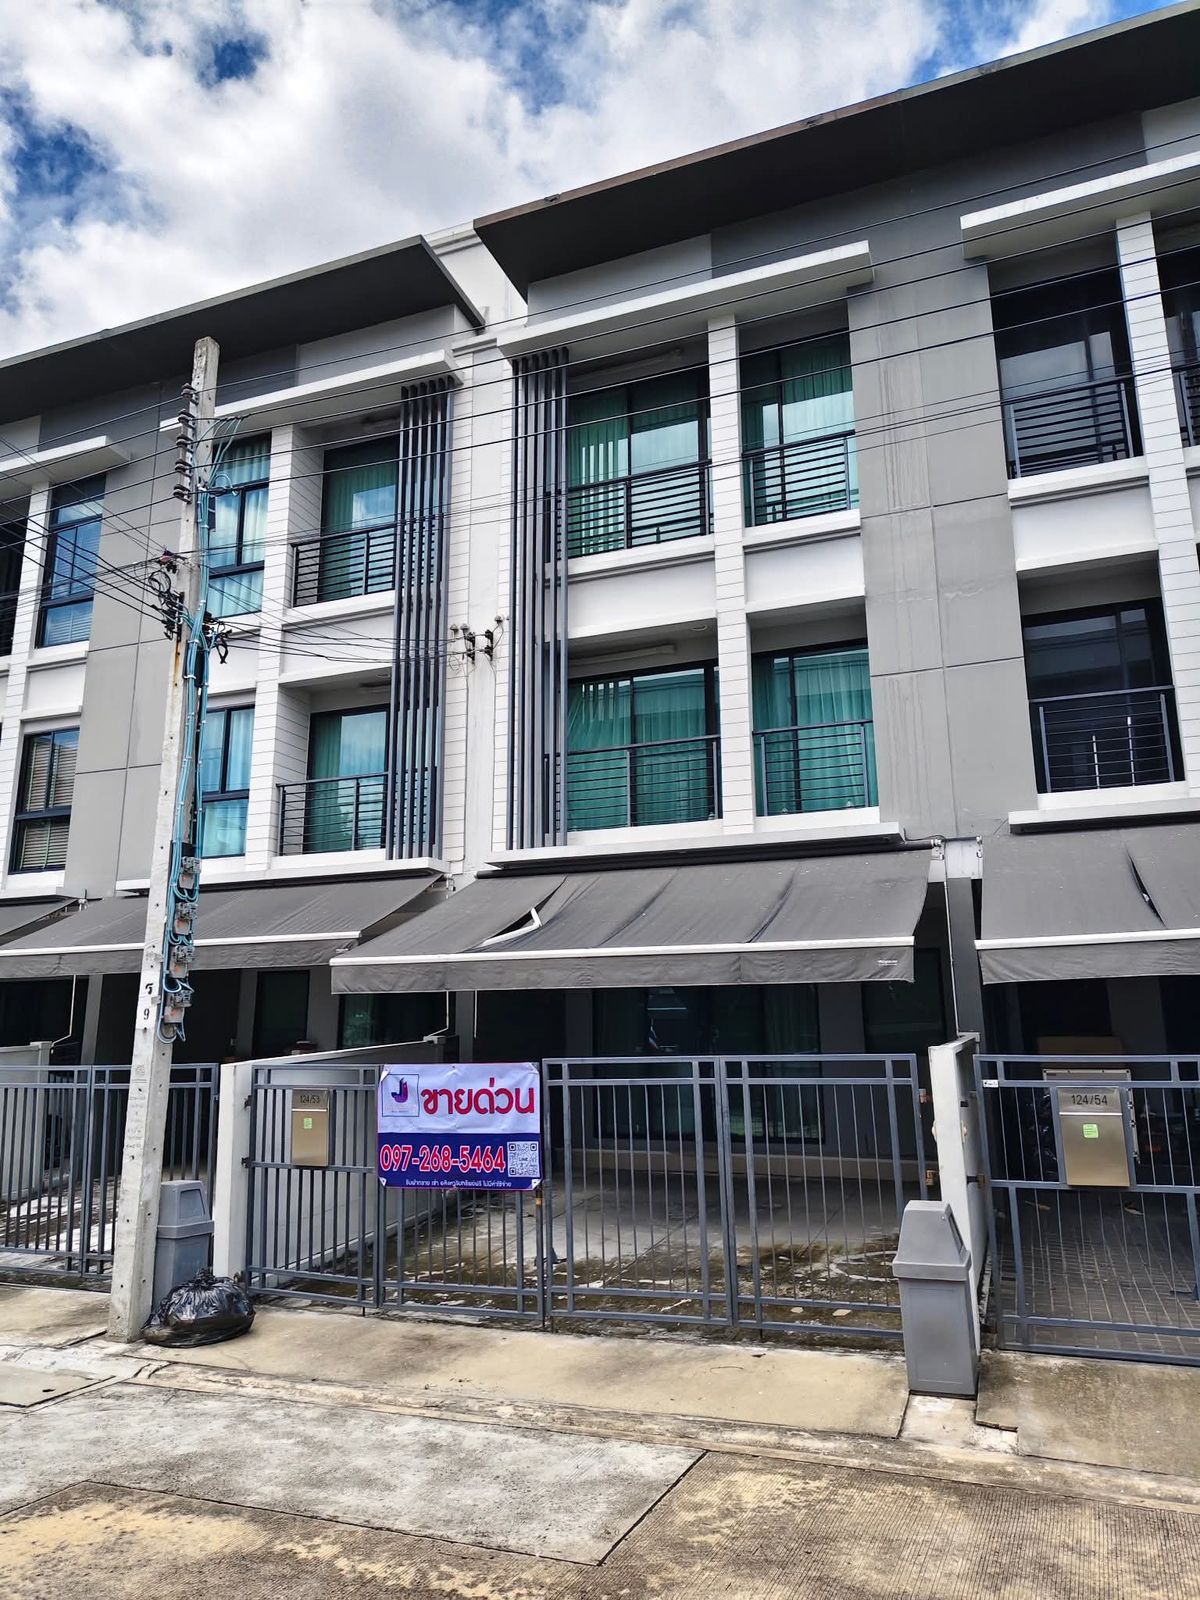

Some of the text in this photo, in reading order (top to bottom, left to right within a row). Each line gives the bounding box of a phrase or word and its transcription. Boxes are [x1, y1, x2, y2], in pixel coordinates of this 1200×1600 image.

[300, 1095, 320, 1104] 124/53
[420, 1077, 535, 1115] ขายด่วน
[1071, 1094, 1108, 1105] 124/54
[380, 1144, 506, 1173] 097-268-5464
